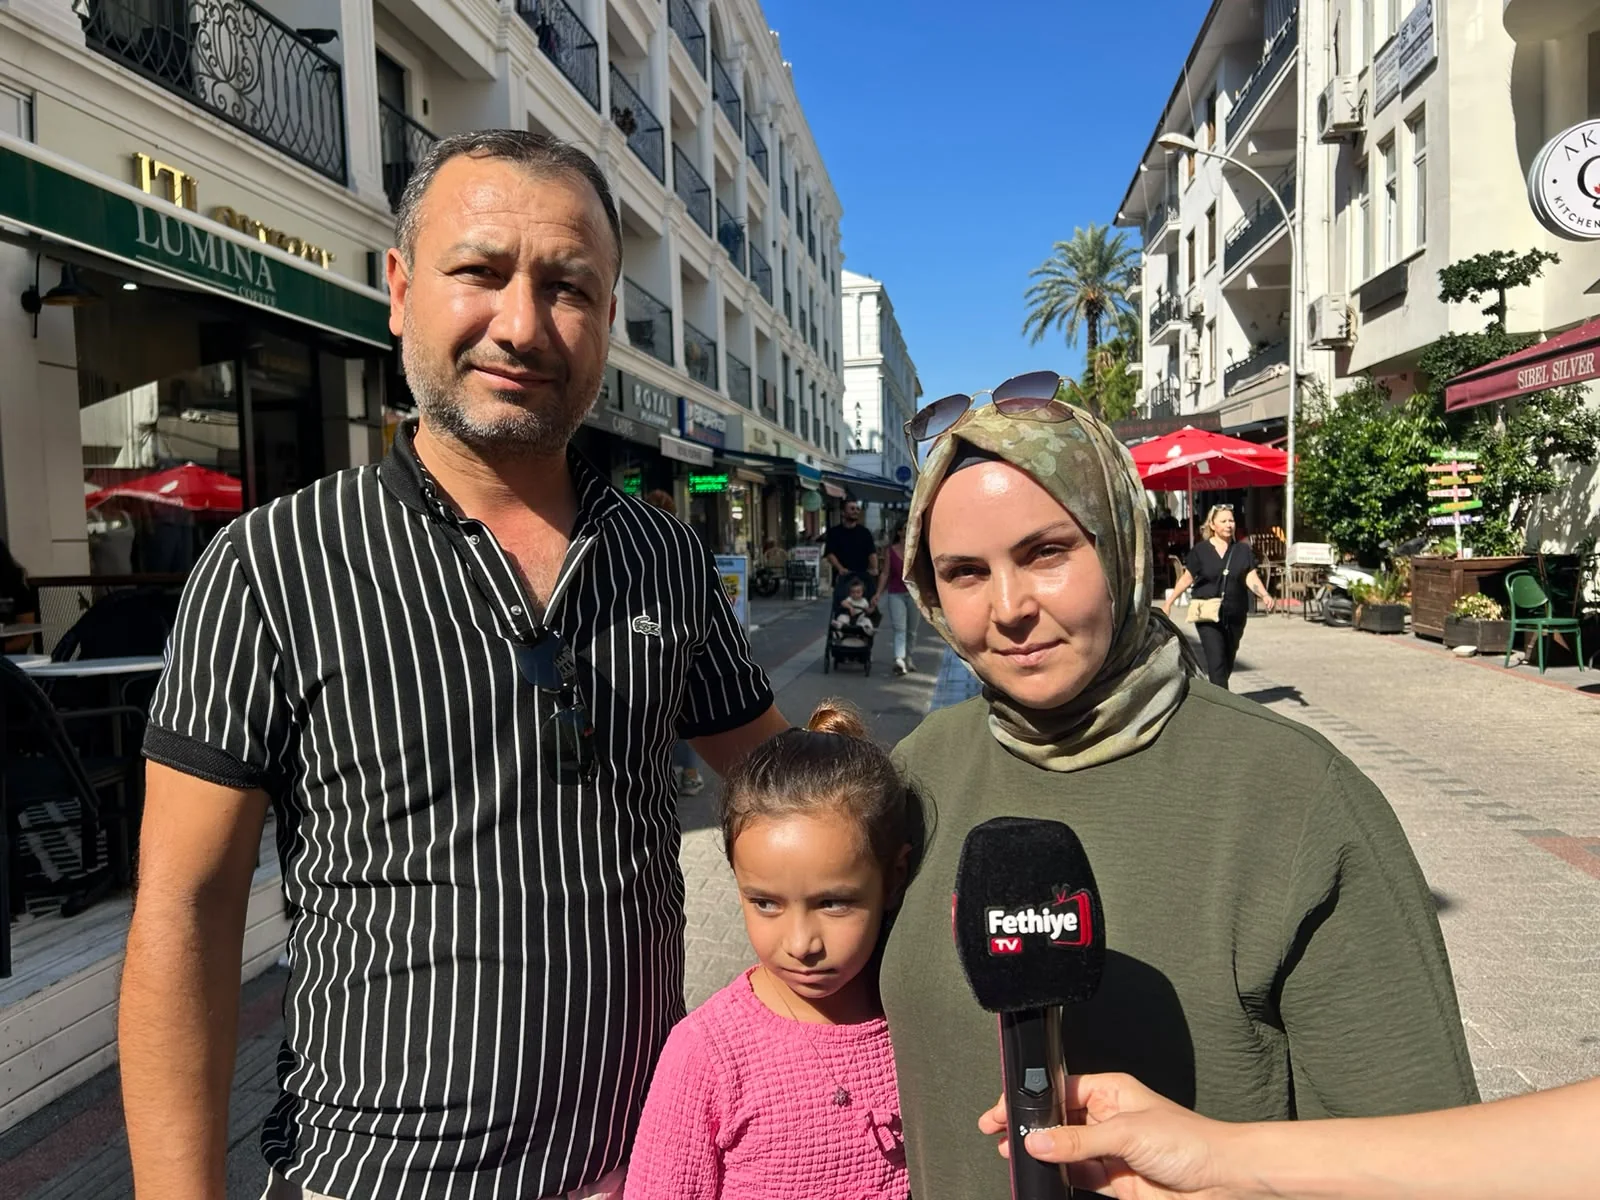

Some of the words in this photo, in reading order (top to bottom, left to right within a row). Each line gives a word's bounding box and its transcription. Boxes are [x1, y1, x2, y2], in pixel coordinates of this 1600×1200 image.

[134, 202, 276, 292] LUMINA
[1518, 364, 1549, 389] SIBEL
[1552, 352, 1595, 381] SILVER
[634, 384, 672, 418] ROYAL
[989, 908, 1077, 940] Fethiye
[995, 939, 1019, 951] TV
